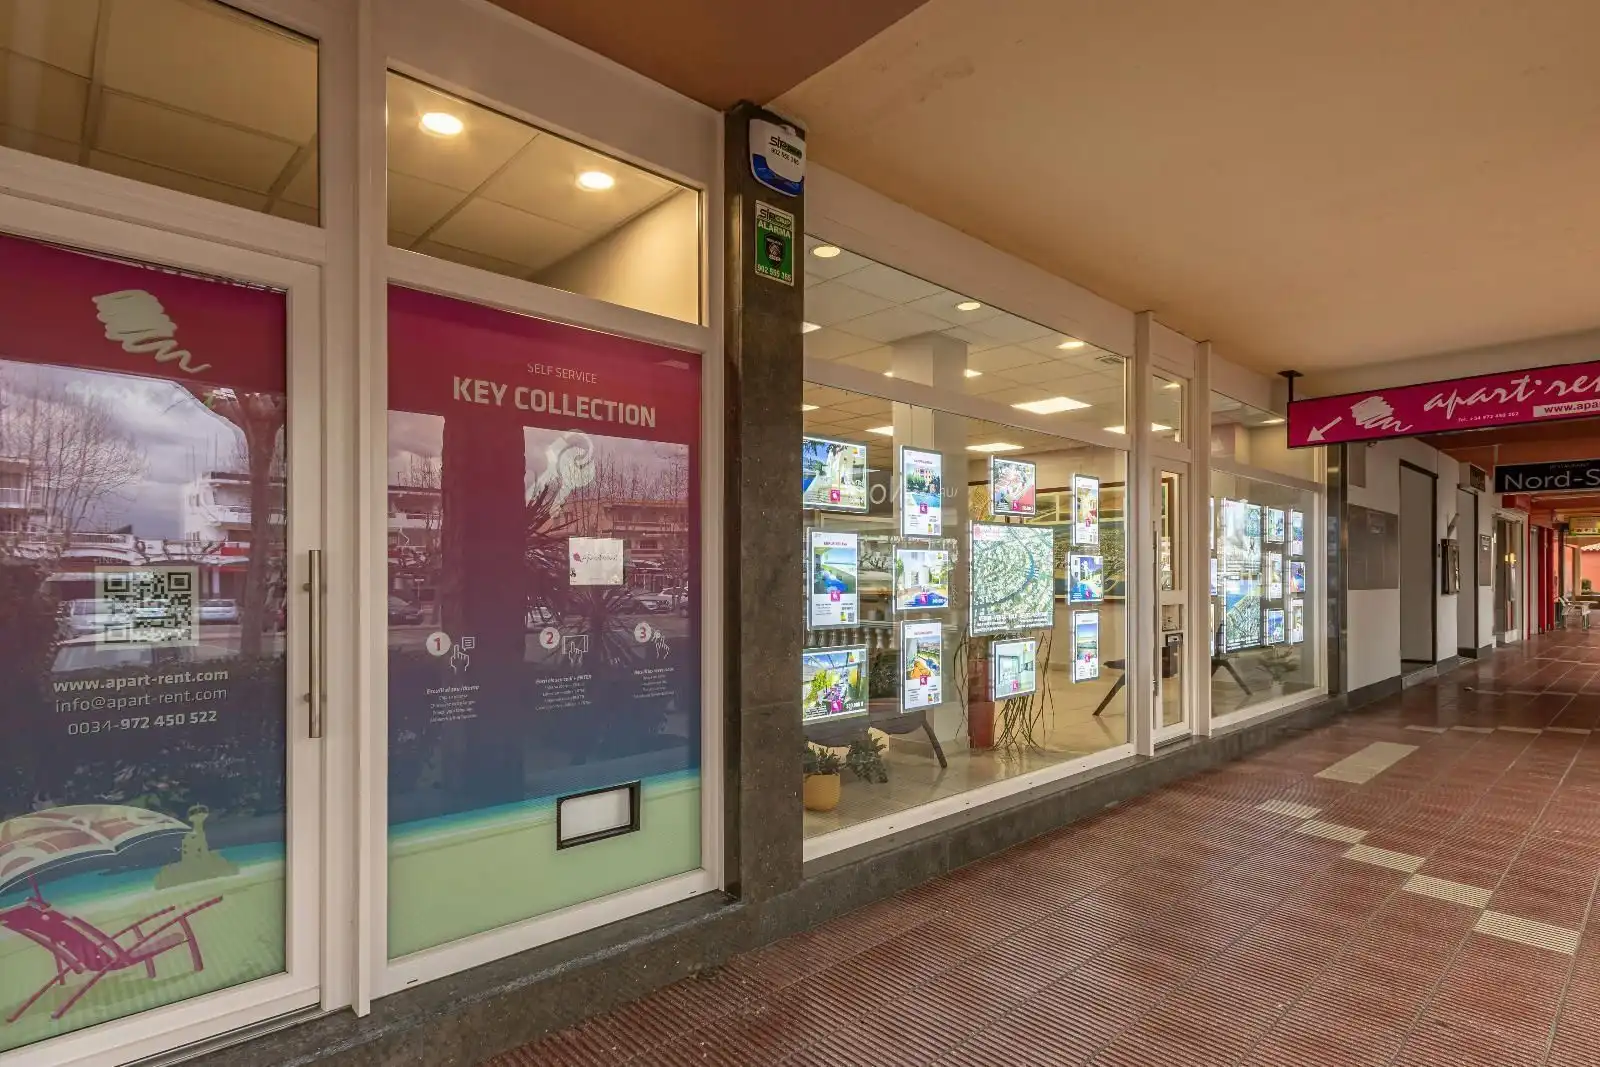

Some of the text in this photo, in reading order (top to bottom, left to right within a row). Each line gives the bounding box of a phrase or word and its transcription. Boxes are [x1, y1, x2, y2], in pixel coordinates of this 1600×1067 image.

[758, 219, 791, 238] ALARMA
[527, 362, 598, 384] SELF SERVICE
[453, 376, 656, 428] KEY COLLECTION
[1544, 400, 1600, 413] www.apa
[545, 631, 554, 645] 2
[639, 626, 647, 639] 3
[434, 637, 441, 651] 1
[53, 670, 229, 693] www.apart-rent.com
[55, 686, 227, 713] info@apart-rent.com
[68, 710, 217, 735] 0034-972 450 522
